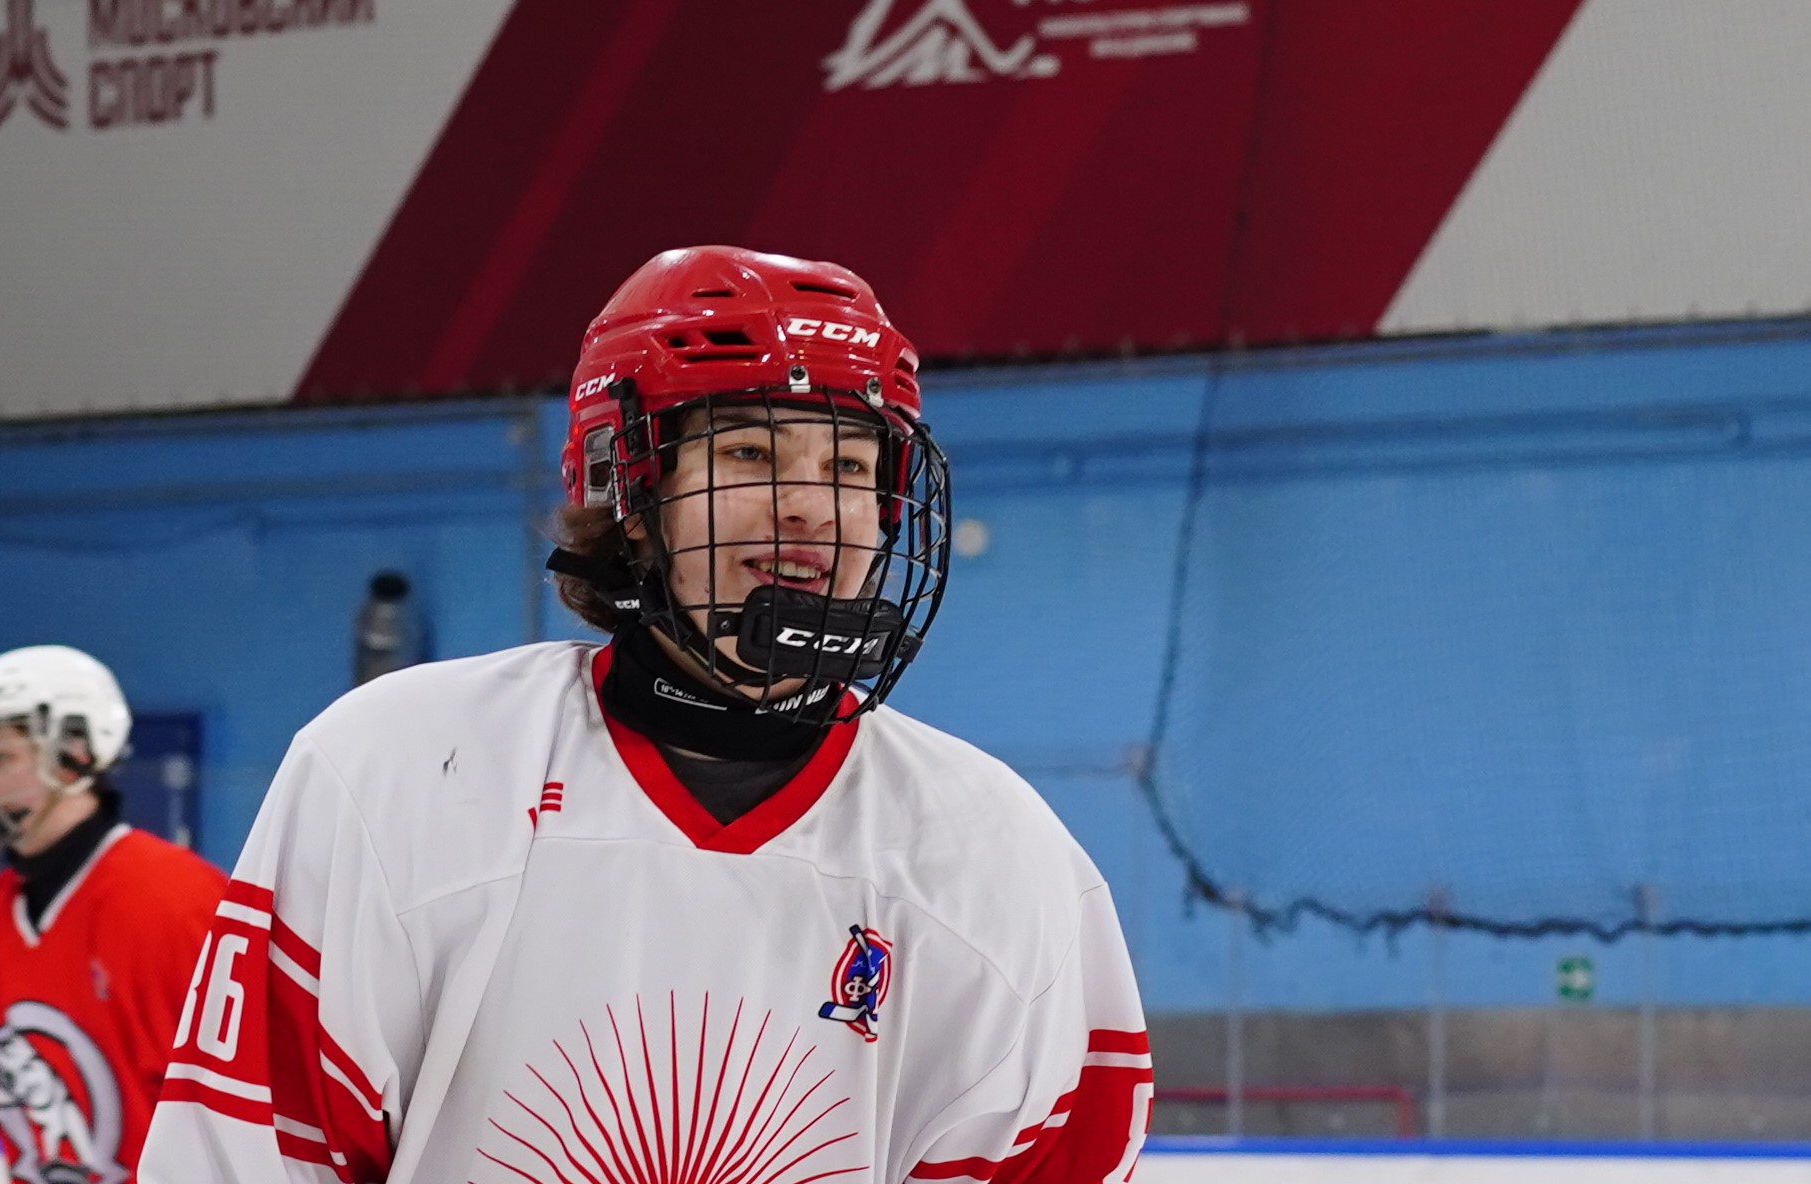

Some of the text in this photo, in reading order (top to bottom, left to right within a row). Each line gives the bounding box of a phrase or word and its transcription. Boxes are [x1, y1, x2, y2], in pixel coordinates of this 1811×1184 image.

[787, 318, 880, 348] CCM
[575, 372, 616, 402] CCM
[776, 626, 879, 655] CCM
